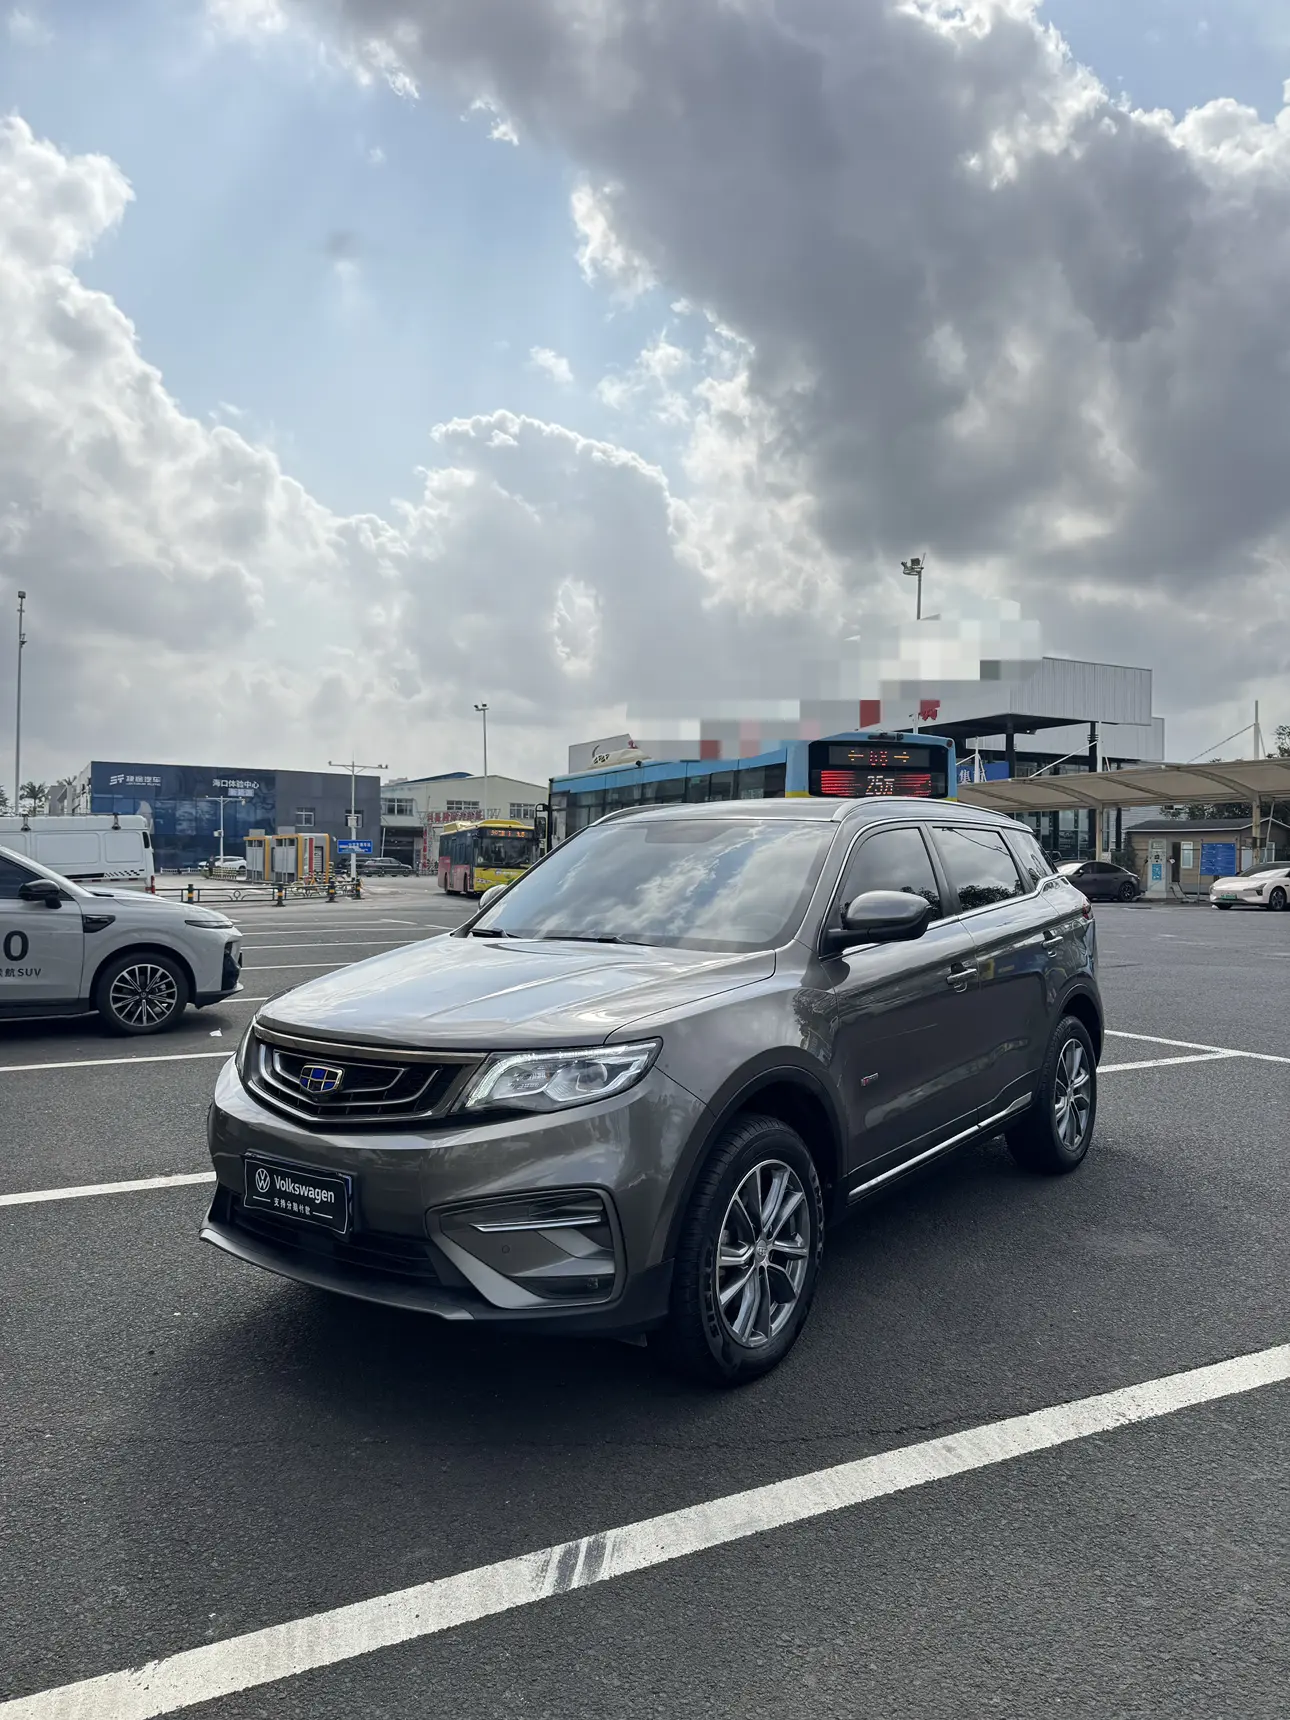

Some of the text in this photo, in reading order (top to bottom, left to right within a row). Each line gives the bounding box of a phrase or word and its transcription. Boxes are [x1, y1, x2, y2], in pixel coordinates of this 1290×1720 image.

[212, 778, 260, 790] 海口体验中心
[273, 1174, 335, 1204] Volkswagen
